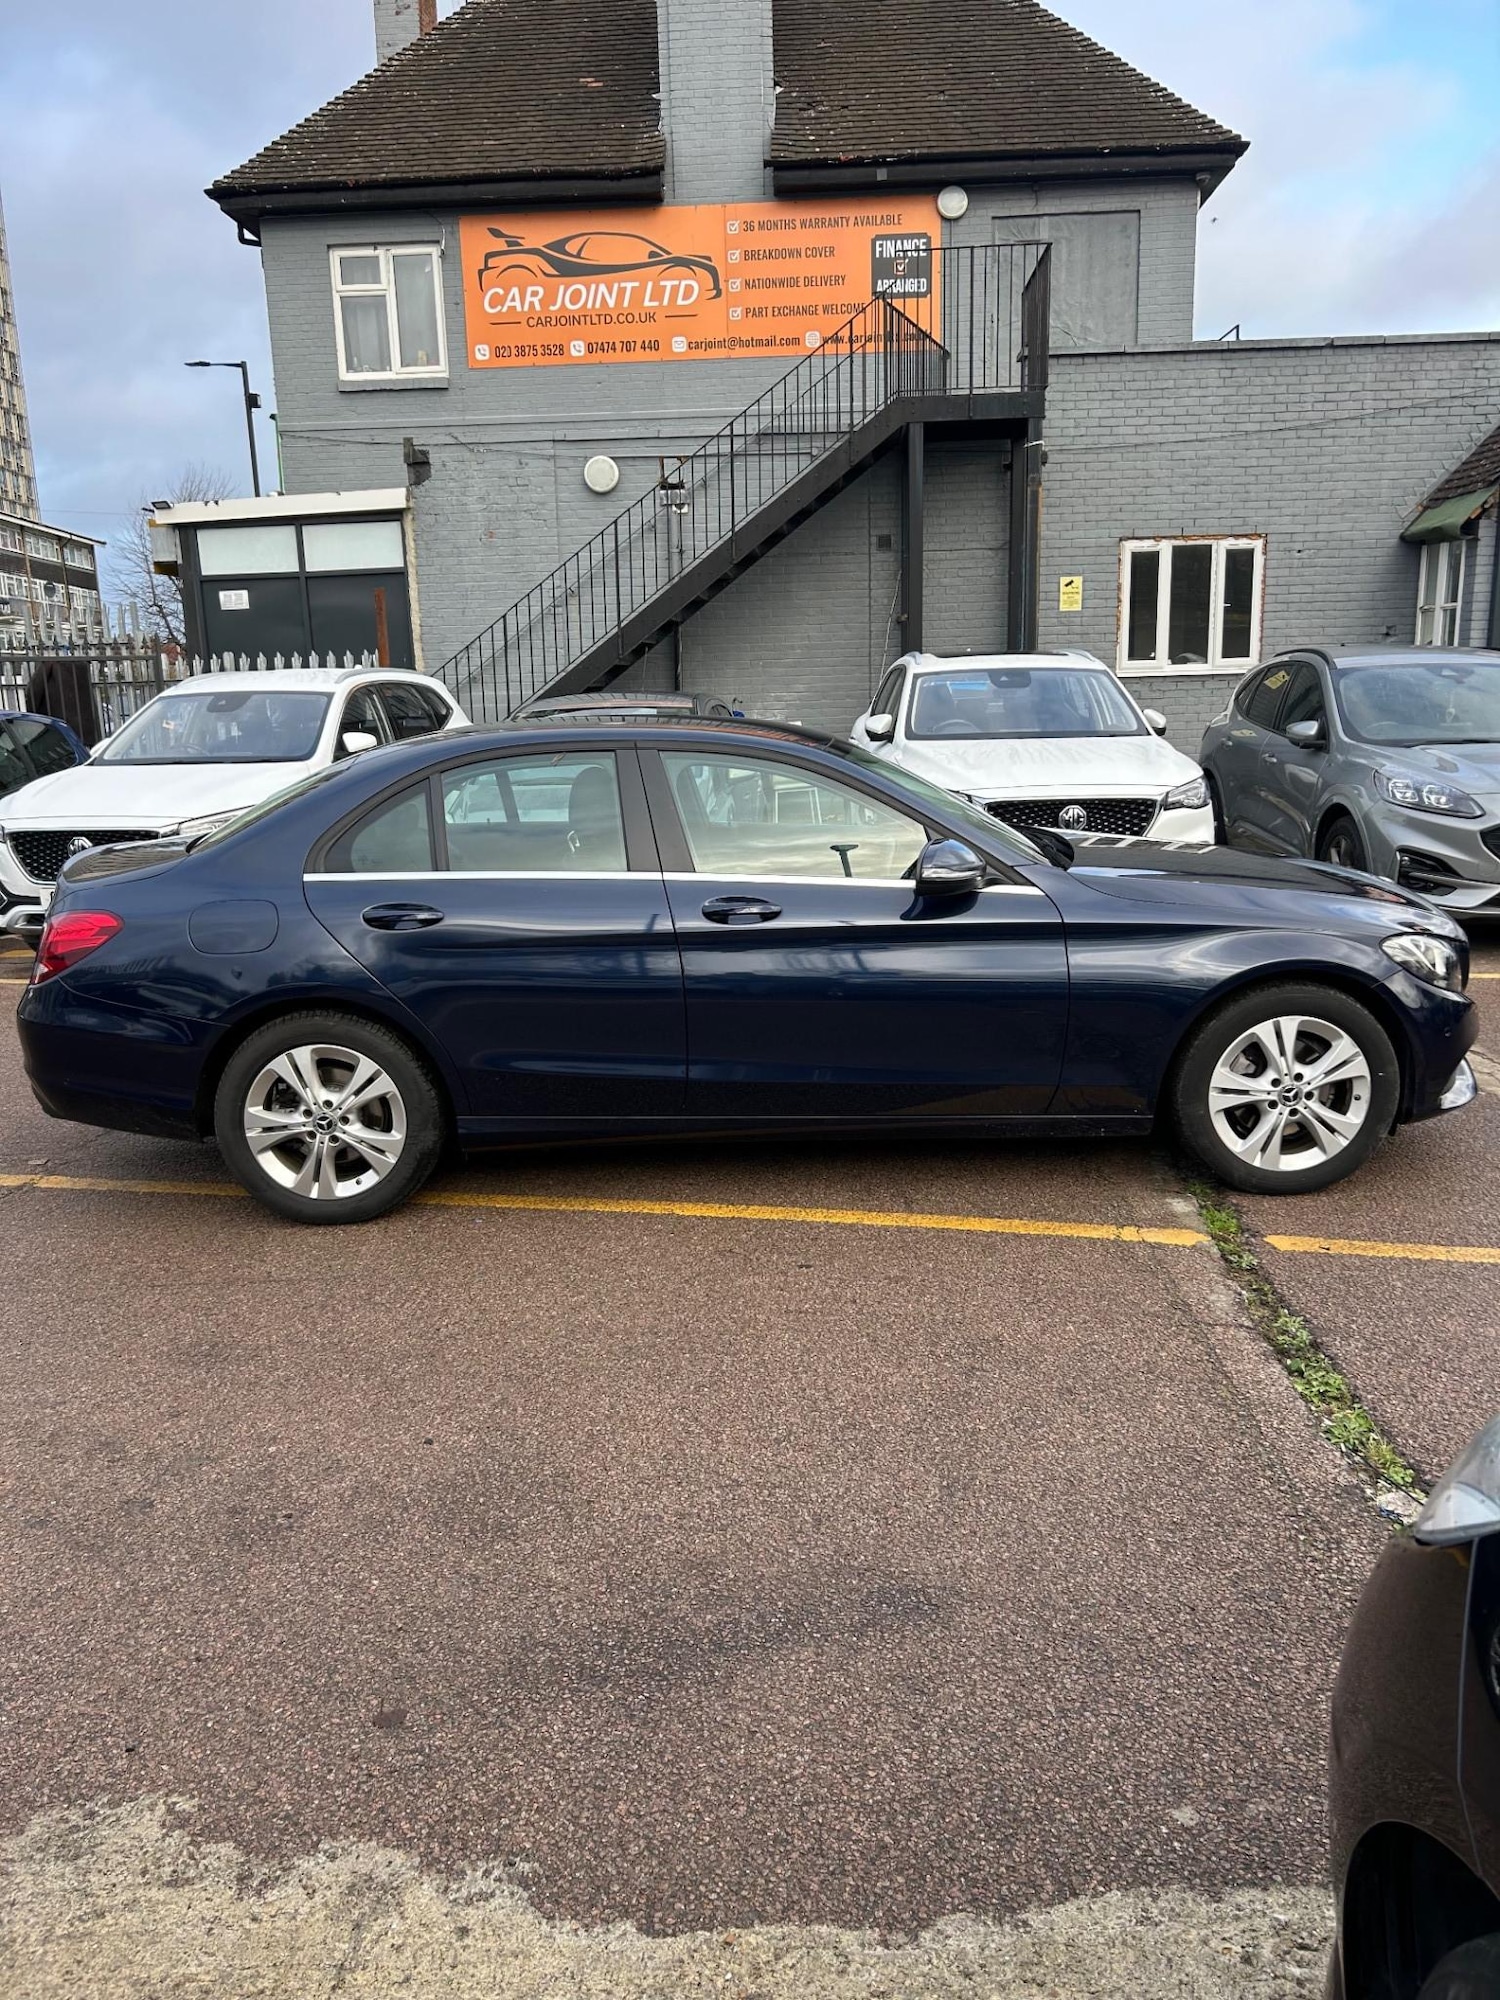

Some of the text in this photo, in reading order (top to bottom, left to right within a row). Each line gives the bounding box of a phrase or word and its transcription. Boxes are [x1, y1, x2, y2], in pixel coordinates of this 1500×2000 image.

[743, 213, 902, 232] 36 MONTHS WARRANTY AVAILABLE
[744, 246, 835, 261] BREAKDOWN COVER
[875, 238, 927, 258] FINANCE
[745, 274, 846, 290] NATIONWIDE DELIVERY
[483, 279, 699, 313] CAR JOINT LTD
[745, 302, 865, 318] PART EXCHANGE WELCOME
[526, 312, 657, 328] CARJOINTLTD.CO.UK
[514, 344, 538, 357] 3875
[540, 343, 565, 356] 3528
[587, 339, 660, 354] 07474 707 440
[688, 334, 800, 350] carjoint@hotmail.com
[1060, 806, 1086, 830] MG
